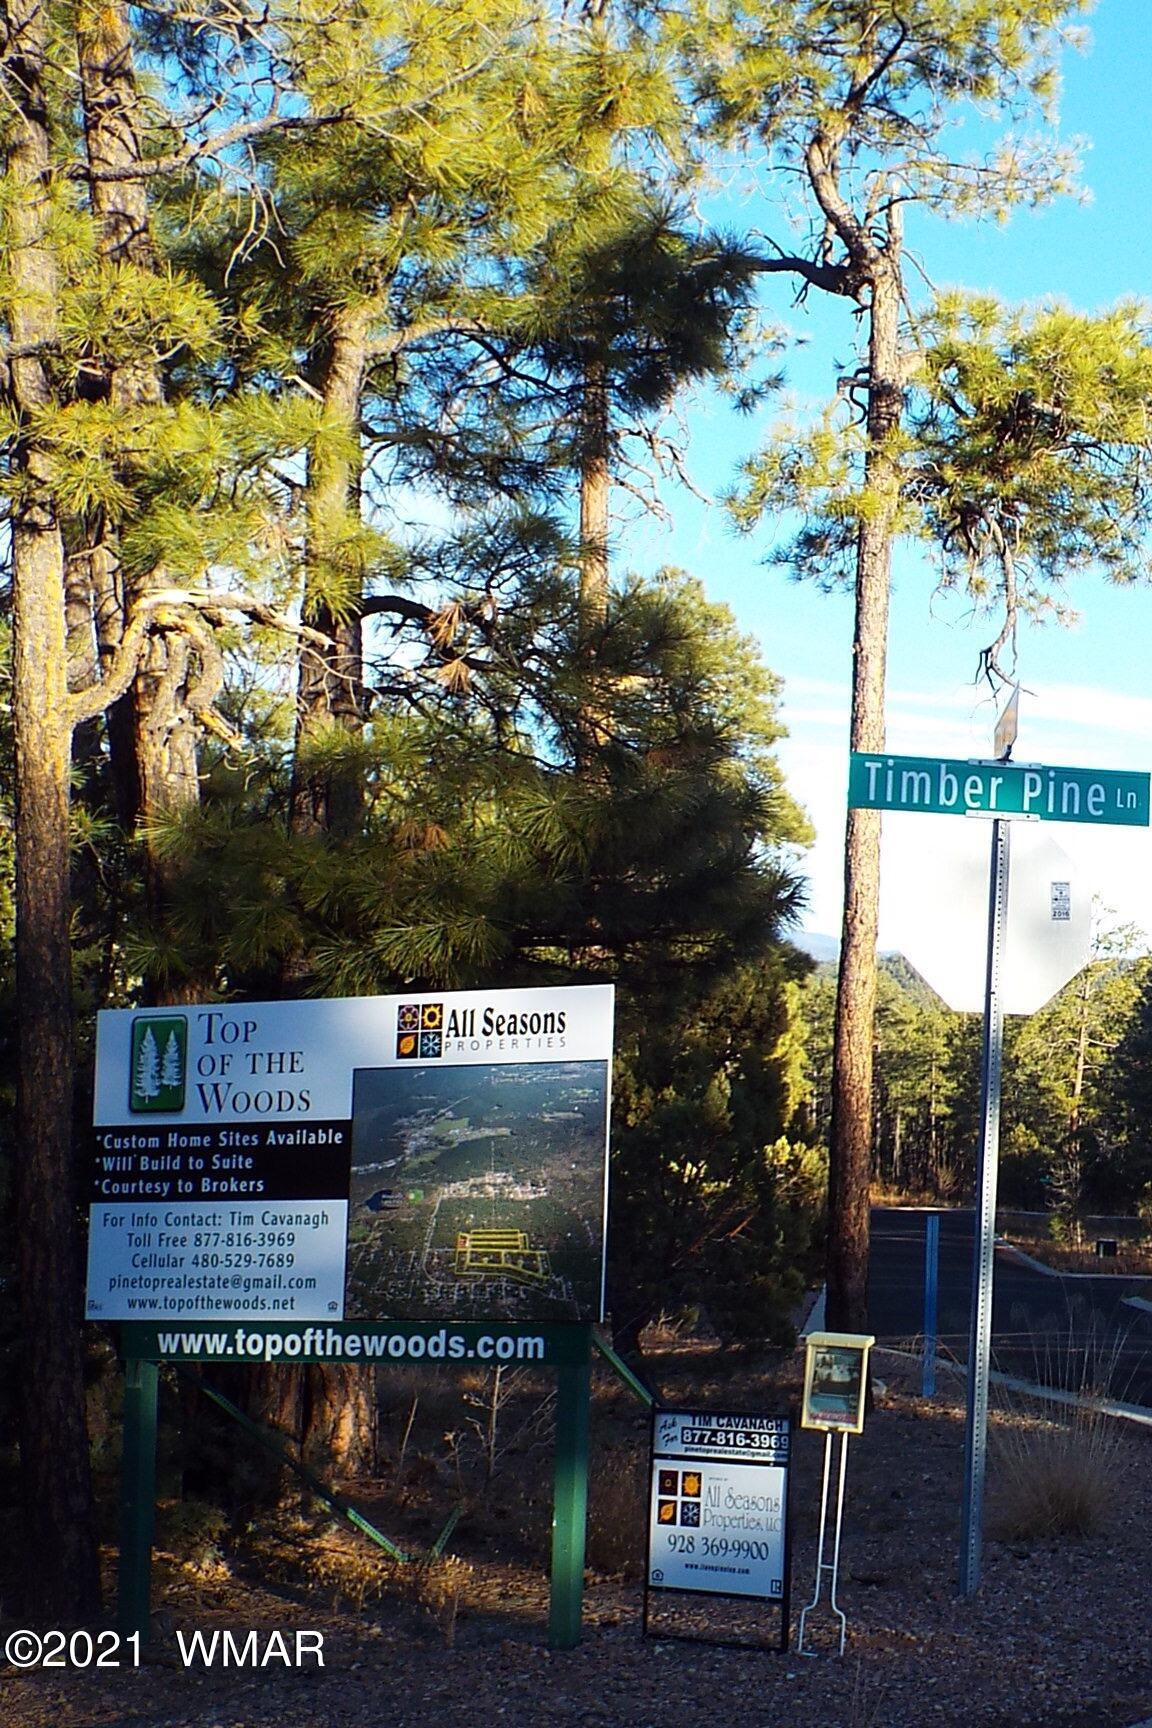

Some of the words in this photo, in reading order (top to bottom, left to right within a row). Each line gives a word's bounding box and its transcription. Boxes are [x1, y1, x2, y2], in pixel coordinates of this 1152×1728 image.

[864, 759, 1003, 810] Timber
[1022, 770, 1105, 816] Pine
[1116, 787, 1137, 809] Ln
[446, 1008, 476, 1038] All
[481, 1007, 567, 1037] Seasons
[444, 1037, 567, 1051] PROPERTIES
[197, 1053, 234, 1077] OF
[245, 1051, 304, 1075] THE
[103, 1133, 160, 1150] Custom
[168, 1132, 211, 1148] Home
[218, 1130, 259, 1147] Sites
[266, 1128, 343, 1145] Available
[102, 1155, 132, 1171] Will
[140, 1155, 181, 1170] Build
[188, 1156, 204, 1170] to
[211, 1154, 253, 1169] Suite
[101, 1178, 171, 1197] Courtesy
[177, 1179, 193, 1193] to
[201, 1177, 265, 1193] Brokers
[103, 1212, 125, 1228] For
[131, 1212, 158, 1227] Info
[164, 1212, 222, 1227] Contact:
[230, 1211, 254, 1226] Tim
[261, 1210, 329, 1229] Cavanagh
[127, 1233, 150, 1247] Toll
[158, 1233, 187, 1247] Free
[194, 1232, 295, 1247] 877-816-3969
[131, 1253, 184, 1268] Cellular
[191, 1253, 295, 1268] 480-529-7689
[109, 1274, 317, 1292] pinetoprealestate@gmail.com
[127, 1296, 295, 1312] www.topofthewoods.net
[157, 1327, 545, 1361] www.topofthewoods.com
[689, 1415, 712, 1428] TIM
[716, 1416, 783, 1432] CAVANAGH
[682, 1429, 789, 1450] 877-816-3969
[705, 1485, 720, 1507] All
[725, 1487, 780, 1512] Seasons
[668, 1534, 695, 1554] 928
[701, 1537, 769, 1561] 369-9900
